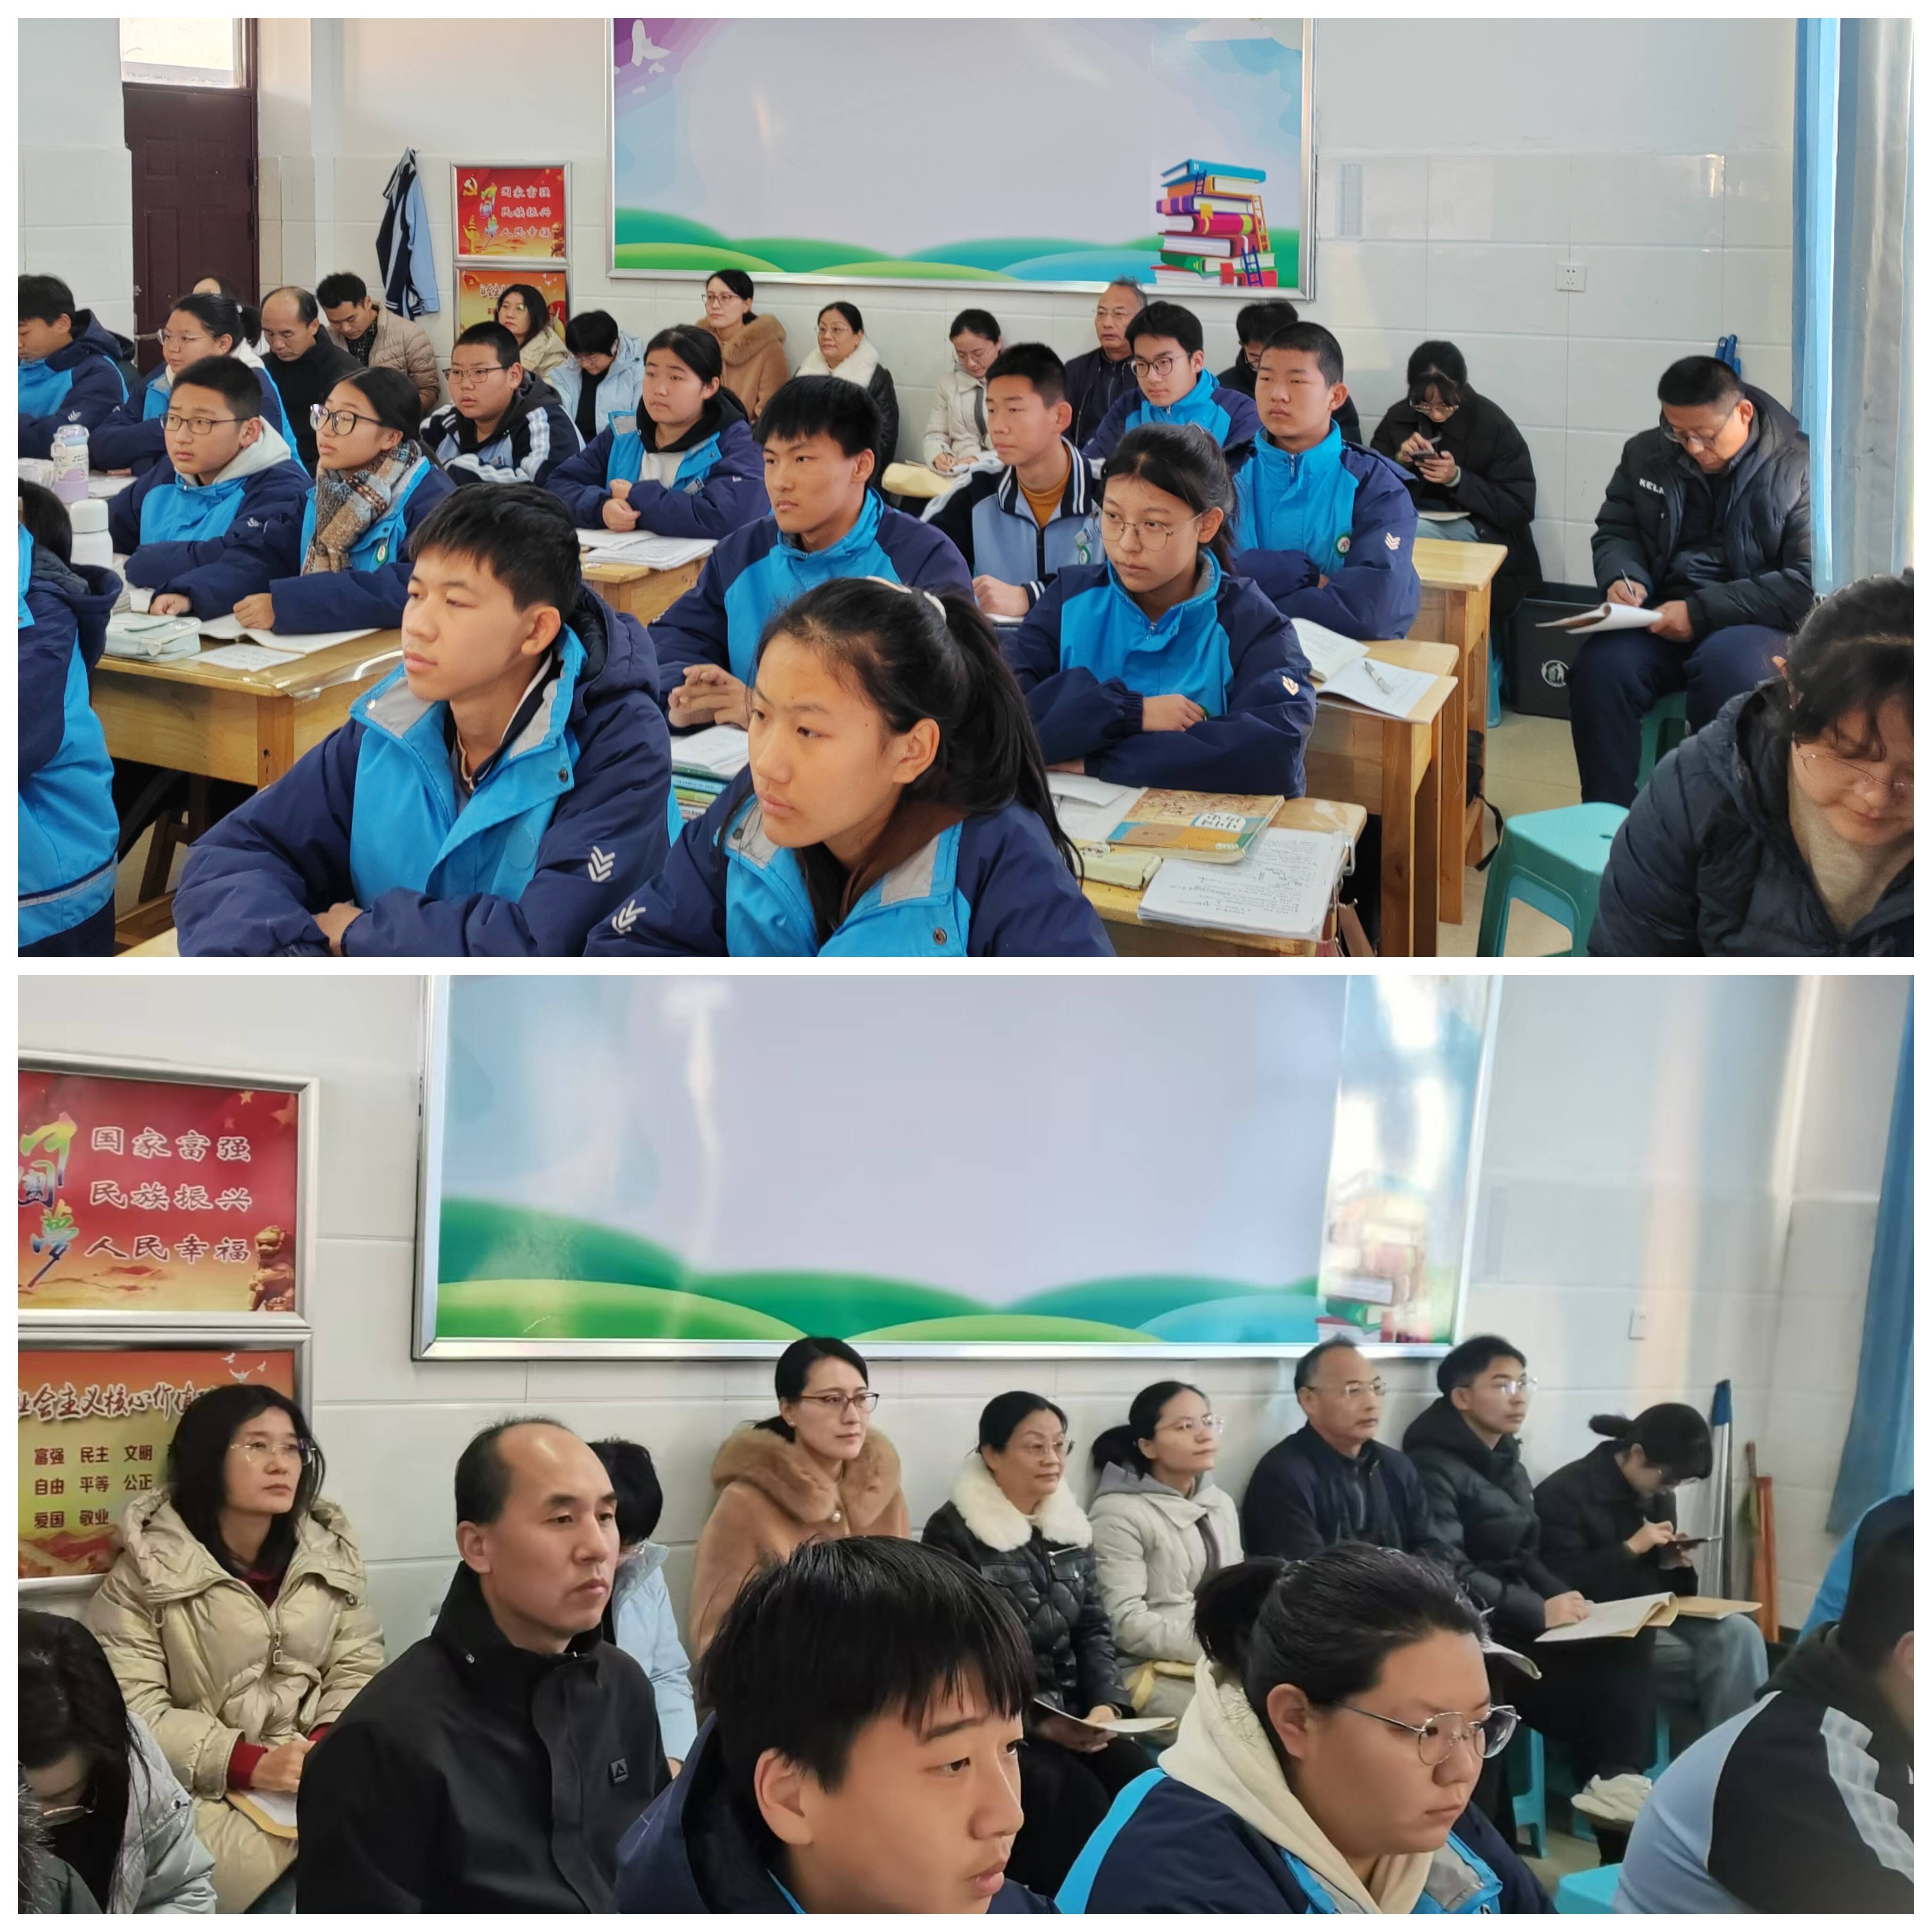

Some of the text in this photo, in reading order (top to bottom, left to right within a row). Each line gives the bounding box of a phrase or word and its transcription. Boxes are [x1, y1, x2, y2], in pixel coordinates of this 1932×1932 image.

[500, 185, 550, 199] 国家富强
[501, 206, 551, 218] 民族振兴
[500, 225, 550, 238] 人民幸福
[91, 1125, 251, 1163] 国家富强
[90, 1181, 252, 1213] 民族振兴
[84, 1235, 250, 1264] 人民幸福
[18, 1381, 219, 1422] 社会主义核心价值
[34, 1448, 65, 1466] 富强
[80, 1446, 109, 1463] 民主
[123, 1445, 153, 1462] 文明
[34, 1474, 152, 1495] 自由 平等 公正
[33, 1509, 110, 1529] 爱国 敬业
